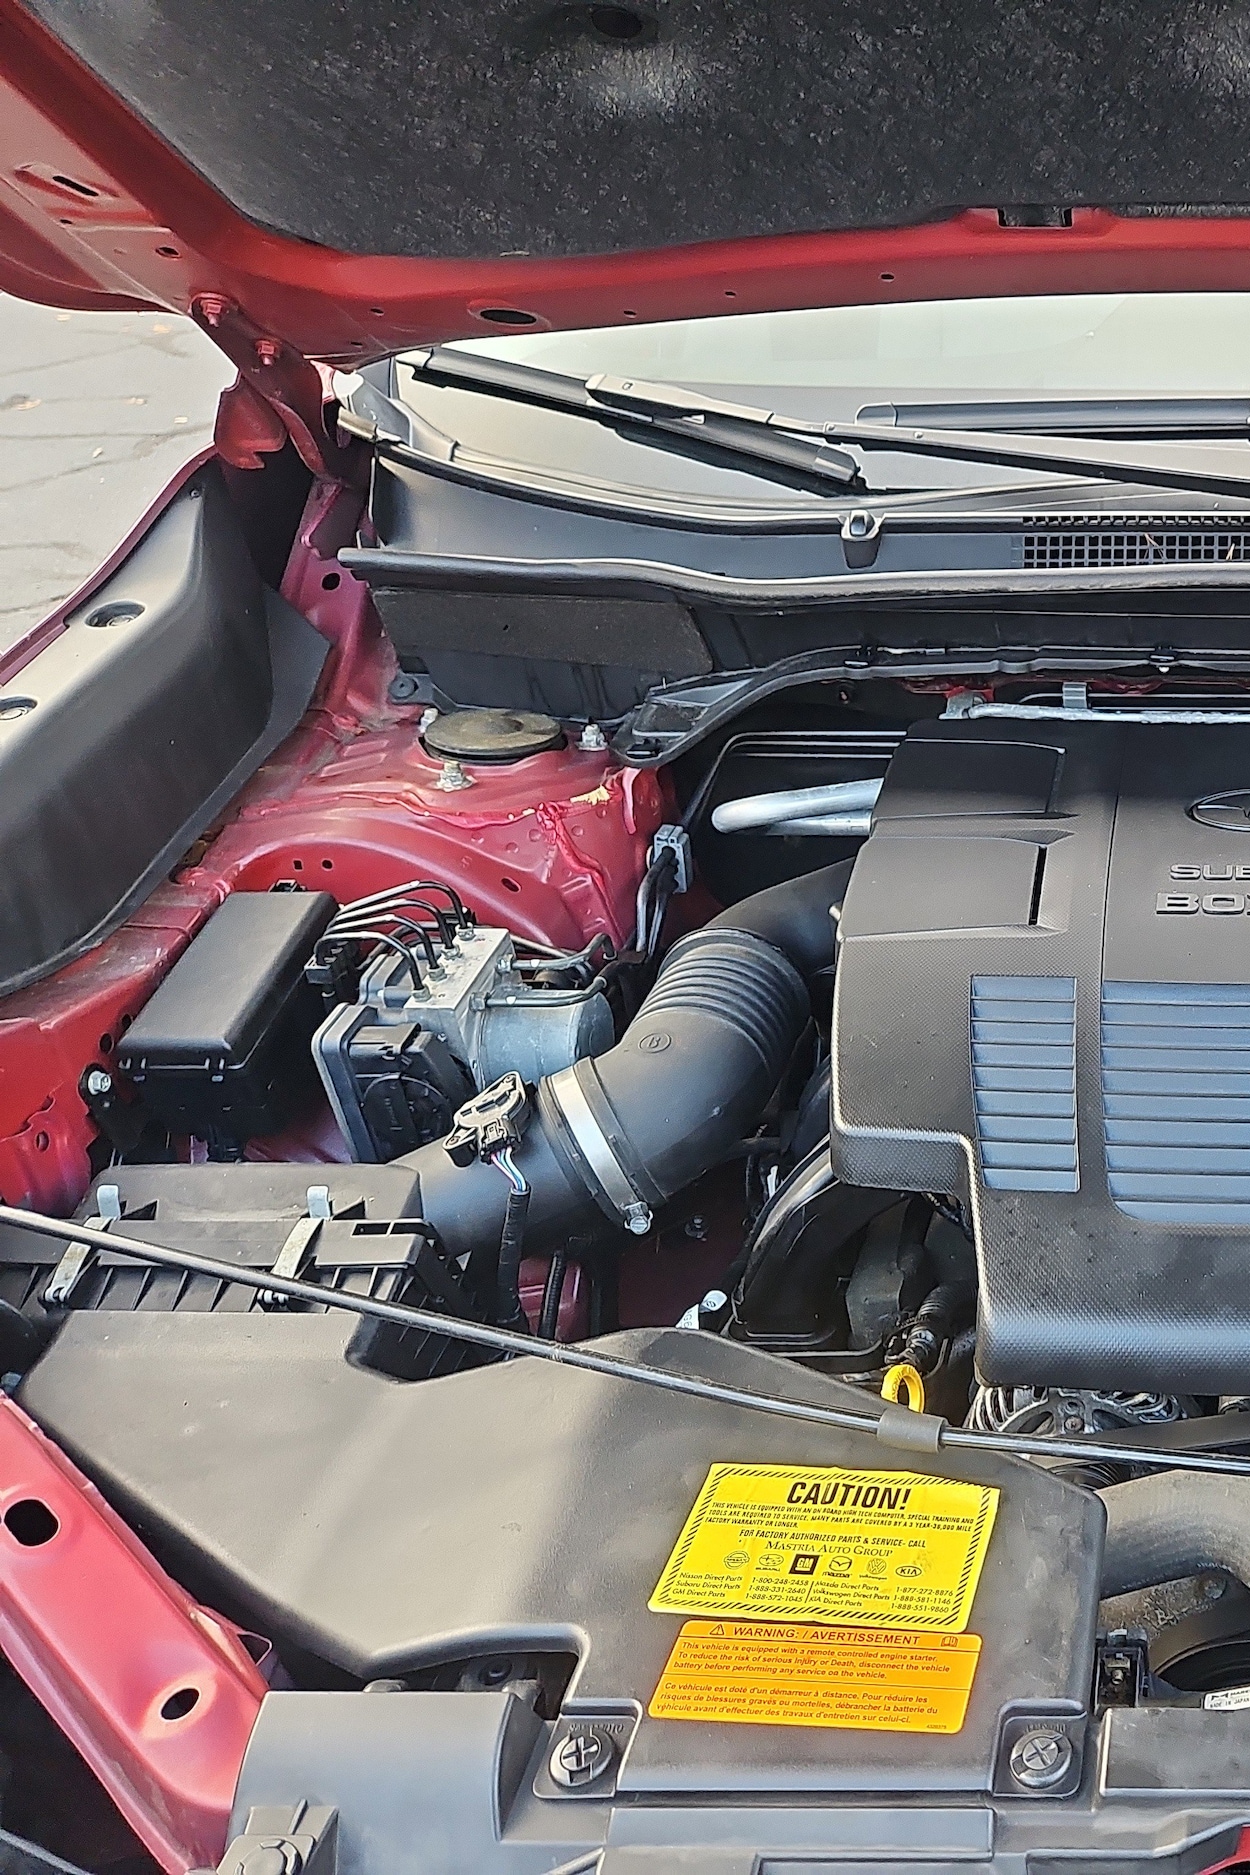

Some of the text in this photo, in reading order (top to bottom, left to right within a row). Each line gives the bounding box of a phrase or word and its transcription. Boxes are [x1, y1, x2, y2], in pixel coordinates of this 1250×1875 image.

[786, 1481, 911, 1510] CAUTION!
[755, 1529, 788, 1539] FACTORY
[789, 1532, 836, 1541] AUTHORIZED
[871, 1537, 905, 1546] SERVICE-
[765, 1540, 892, 1556] MASTRIA AUTO GROUP
[796, 1558, 814, 1569] GM
[734, 1626, 799, 1638] WARNING:
[809, 1630, 920, 1644] AVERTISSEMENT
[701, 1642, 730, 1650] vehicle
[741, 1645, 779, 1653] equipped
[836, 1650, 878, 1658] controlled
[879, 1652, 907, 1660] engine
[673, 1661, 702, 1670] battery
[704, 1662, 730, 1670] before
[731, 1664, 777, 1674] performing
[778, 1667, 794, 1675] any
[796, 1667, 826, 1675] service
[762, 1655, 792, 1663] serious
[794, 1656, 818, 1666] Injury
[830, 1658, 856, 1668] Death,
[858, 1660, 904, 1669] disconnect
[921, 1664, 949, 1672] vehicle
[678, 1683, 712, 1691] véhicule
[728, 1685, 747, 1693] doté
[749, 1686, 767, 1694] d'un
[769, 1687, 812, 1696] démarreur
[822, 1690, 859, 1699] distance.
[861, 1692, 882, 1700] Pour
[883, 1693, 913, 1702] réduire
[656, 1702, 691, 1712] véhicule
[718, 1705, 763, 1714] d'effectuer
[782, 1709, 813, 1717] travaux
[815, 1711, 860, 1720] d'entretien
[660, 1693, 691, 1701] risques
[693, 1693, 704, 1701] de
[705, 1694, 746, 1703] blessures
[791, 1700, 832, 1708] mortelles,
[835, 1701, 881, 1710] débrancher
[883, 1703, 890, 1711] la
[892, 1704, 924, 1713] batterie
